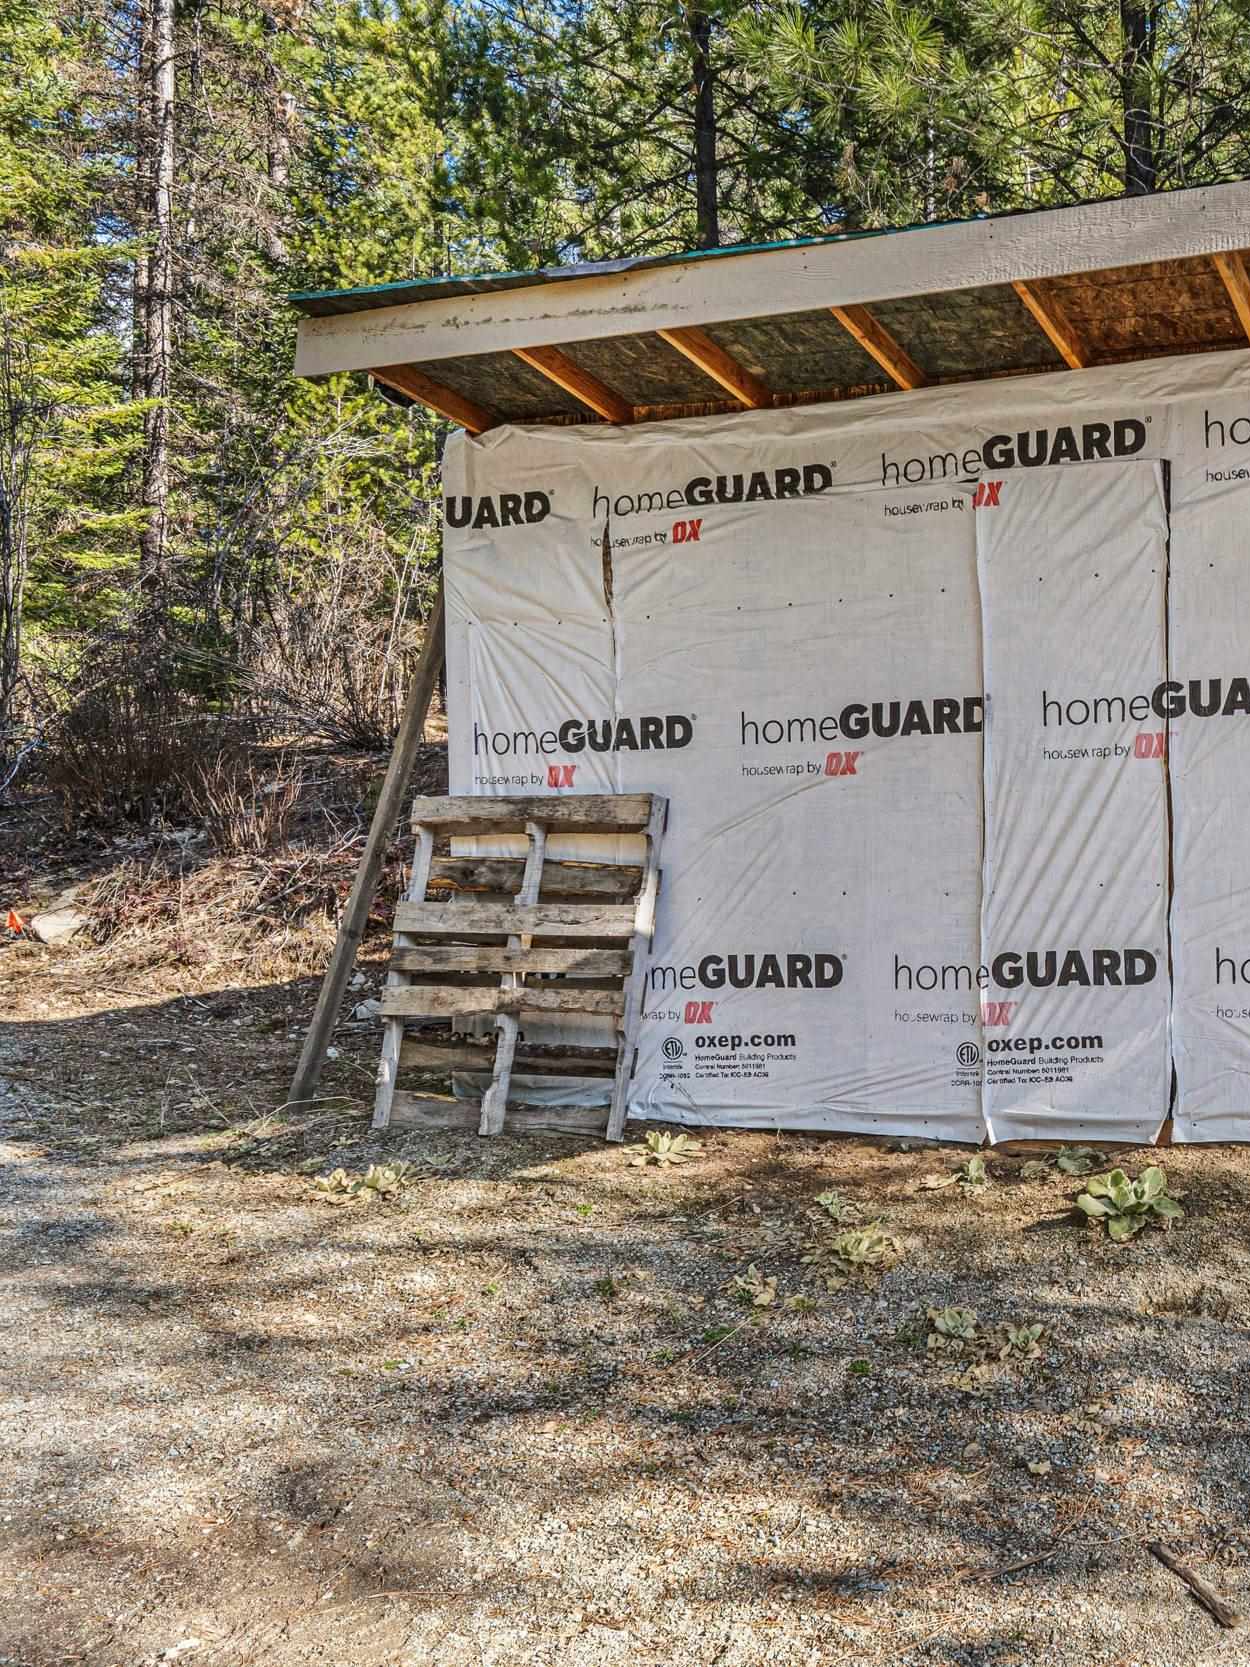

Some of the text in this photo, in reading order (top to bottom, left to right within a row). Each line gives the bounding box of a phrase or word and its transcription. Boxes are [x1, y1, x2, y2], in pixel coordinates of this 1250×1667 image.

[672, 518, 703, 544] OX
[1114, 743, 1131, 757] by
[807, 761, 821, 775] by
[824, 751, 860, 776] OX
[530, 772, 544, 785] by
[685, 1001, 714, 1025] OX
[962, 1010, 977, 1025] by
[695, 1033, 797, 1051] oxep.com
[986, 1034, 1103, 1054] oxep.com
